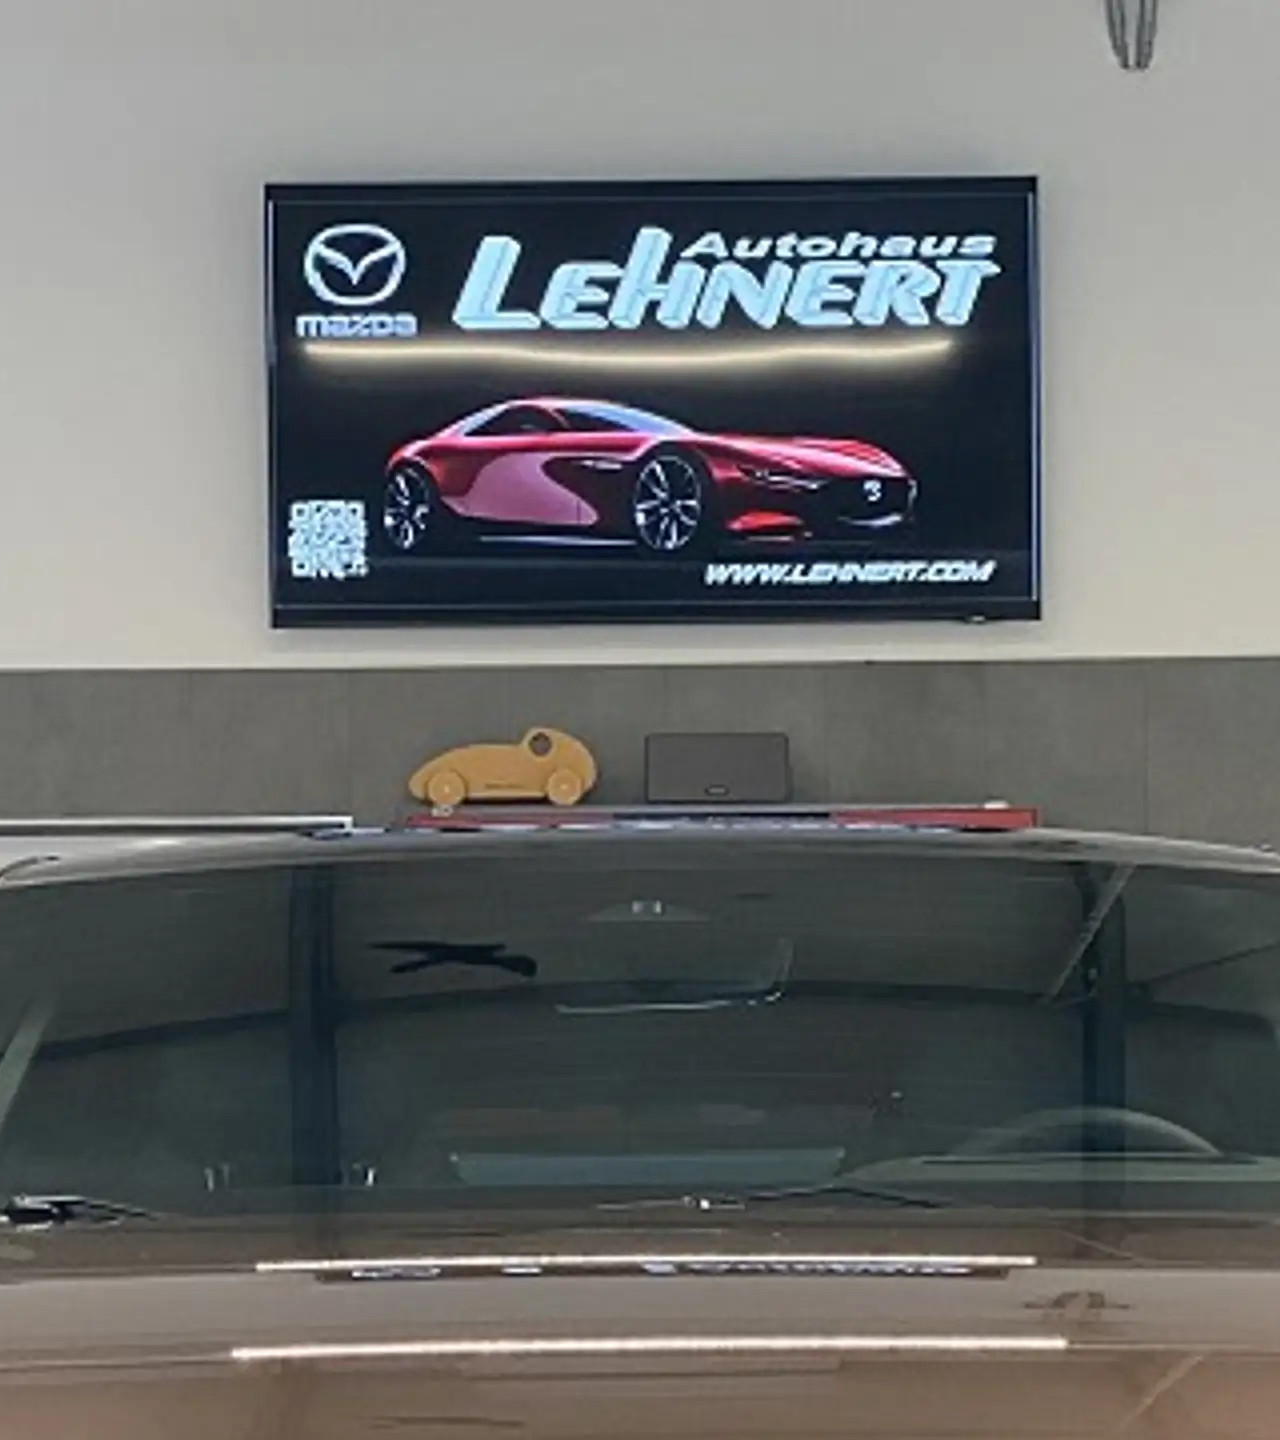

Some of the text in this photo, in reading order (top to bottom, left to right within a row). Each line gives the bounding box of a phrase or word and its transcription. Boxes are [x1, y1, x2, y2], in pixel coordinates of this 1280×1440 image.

[681, 231, 997, 259] Autohaus
[296, 313, 418, 338] mazda
[704, 560, 997, 585] WWW.LEHNERT.COM
